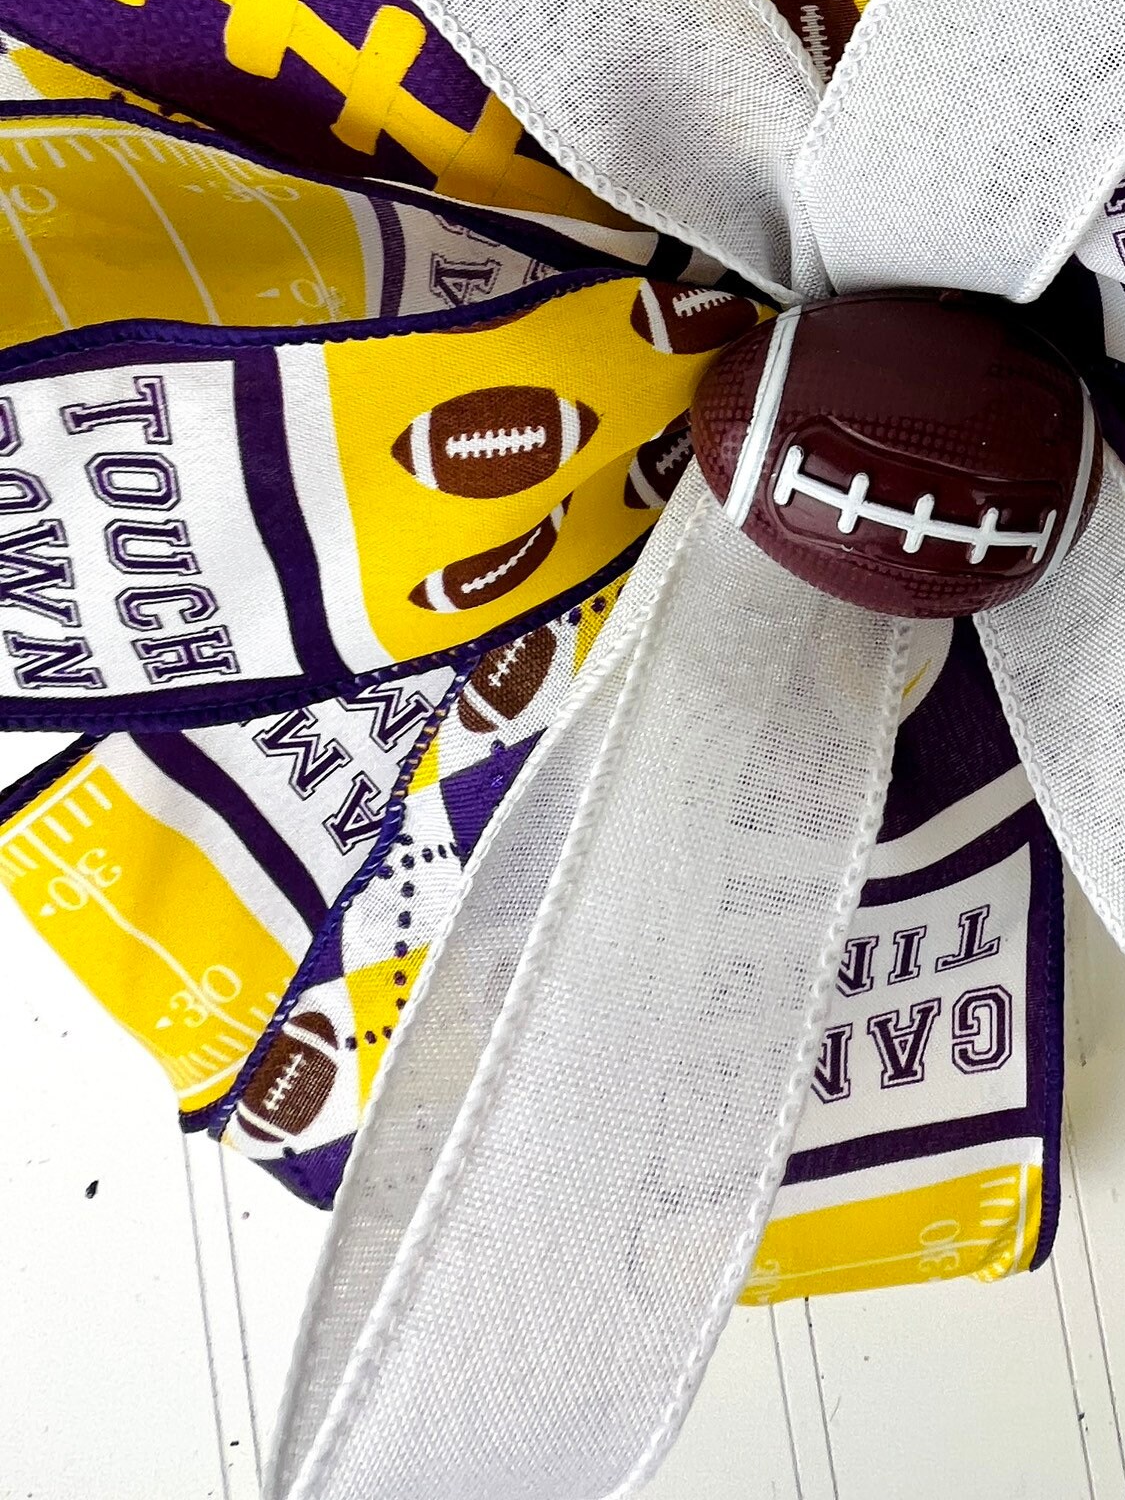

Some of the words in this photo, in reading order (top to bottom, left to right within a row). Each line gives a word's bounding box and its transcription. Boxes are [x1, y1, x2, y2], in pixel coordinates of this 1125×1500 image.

[0, 396, 108, 690] OWN
[60, 375, 241, 685] TOUCH
[46, 846, 122, 912] 30
[169, 963, 244, 1029] 30
